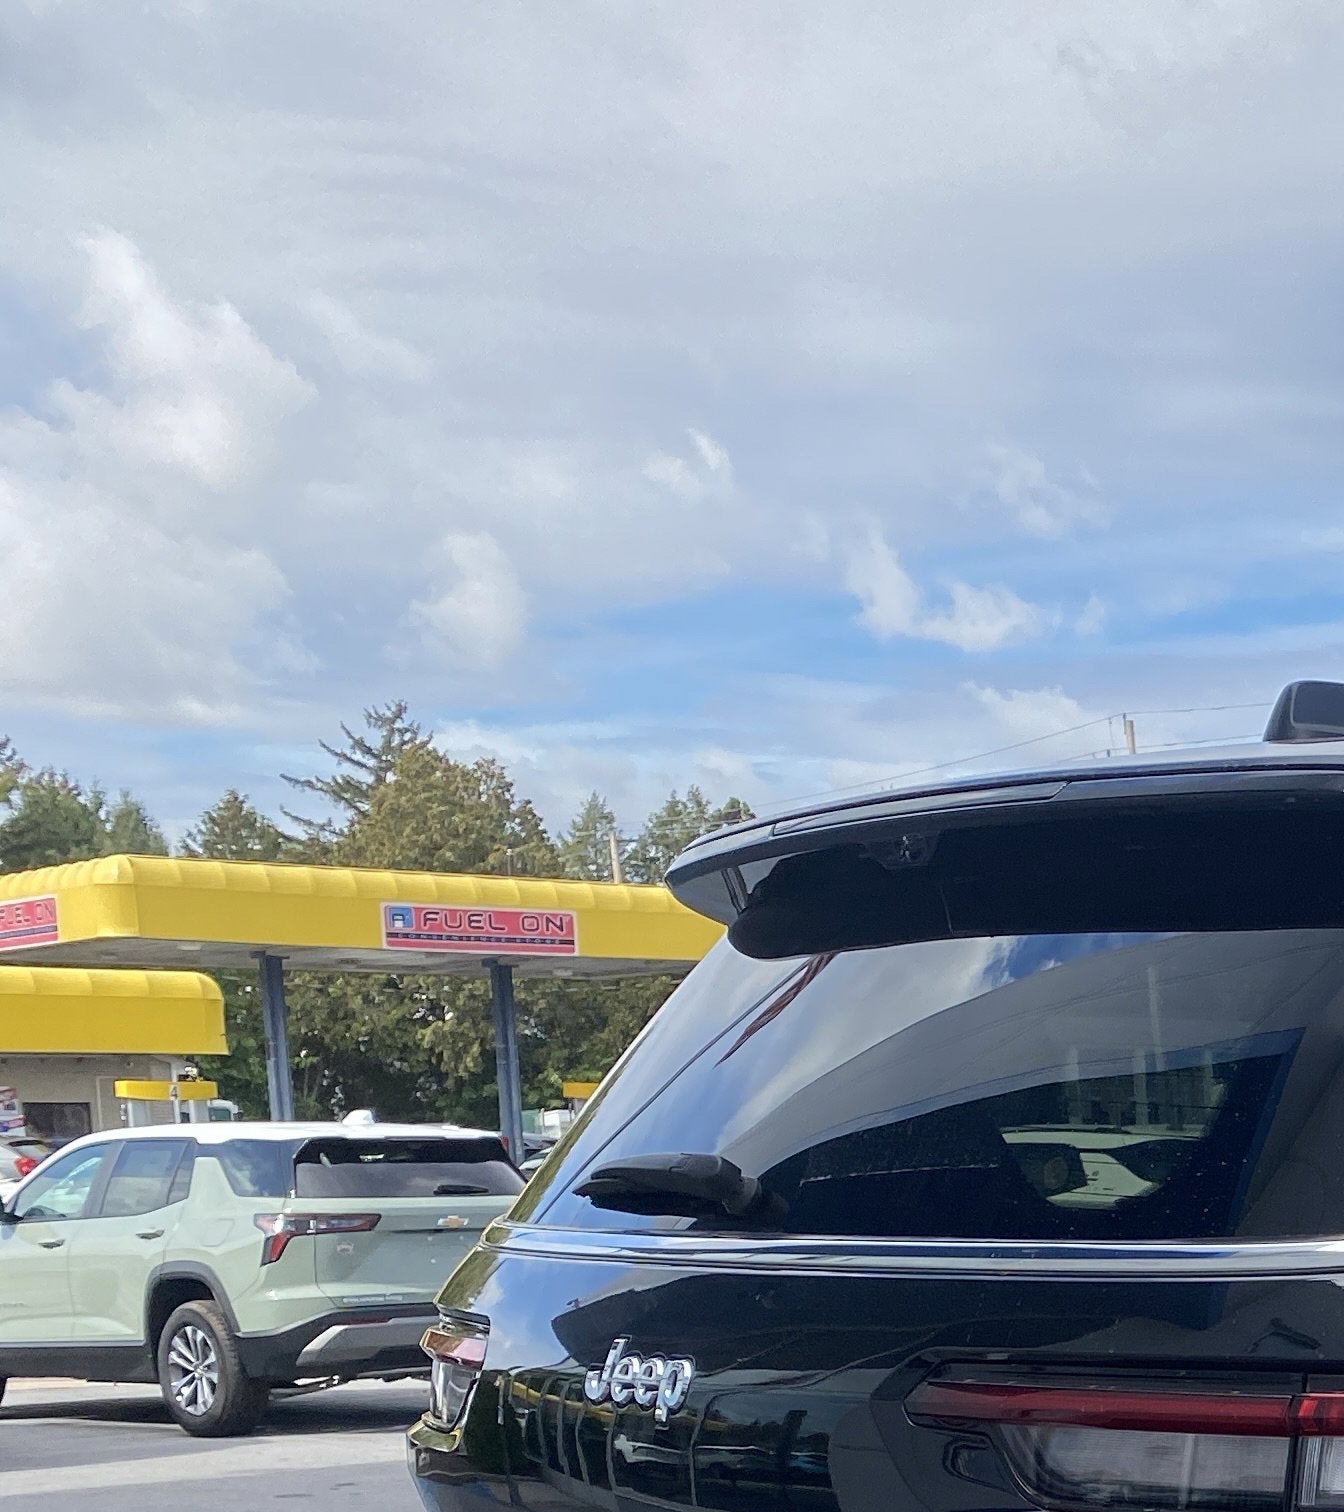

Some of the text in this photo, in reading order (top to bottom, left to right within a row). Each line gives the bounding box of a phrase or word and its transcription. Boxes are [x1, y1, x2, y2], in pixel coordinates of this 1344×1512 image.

[422, 910, 565, 933] FUEL ON
[170, 1085, 179, 1099] 4
[584, 1335, 694, 1424] Jeep
